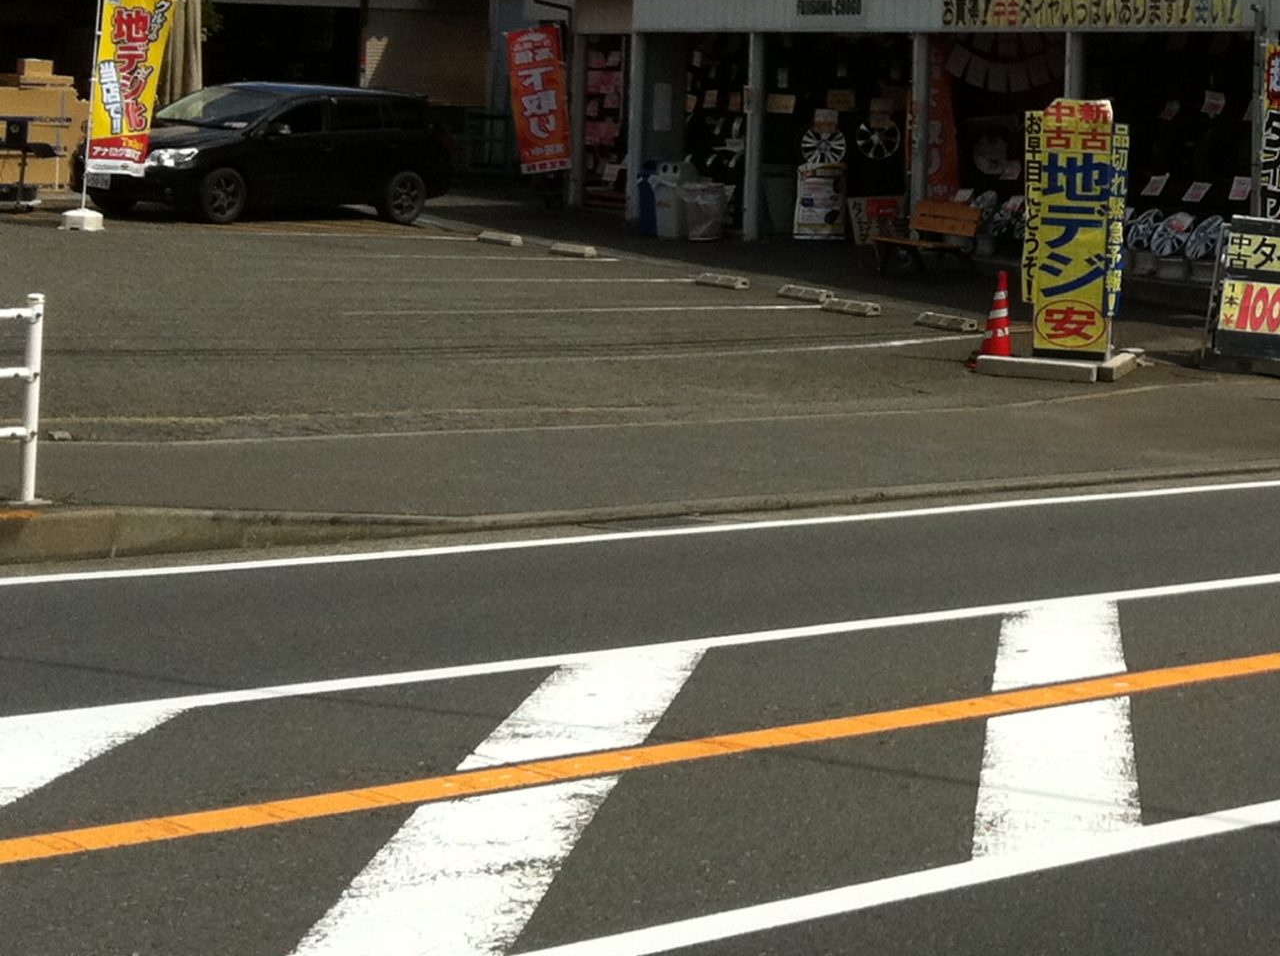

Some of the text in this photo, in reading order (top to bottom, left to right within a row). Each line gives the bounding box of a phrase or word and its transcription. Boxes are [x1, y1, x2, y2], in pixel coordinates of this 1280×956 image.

[112, 7, 153, 132] 地デジ化
[1044, 101, 1075, 150] 中古
[1079, 102, 1111, 151] 新古
[1040, 152, 1112, 298] 地デジ
[1225, 234, 1252, 269] 中古
[1043, 306, 1096, 341] 安
